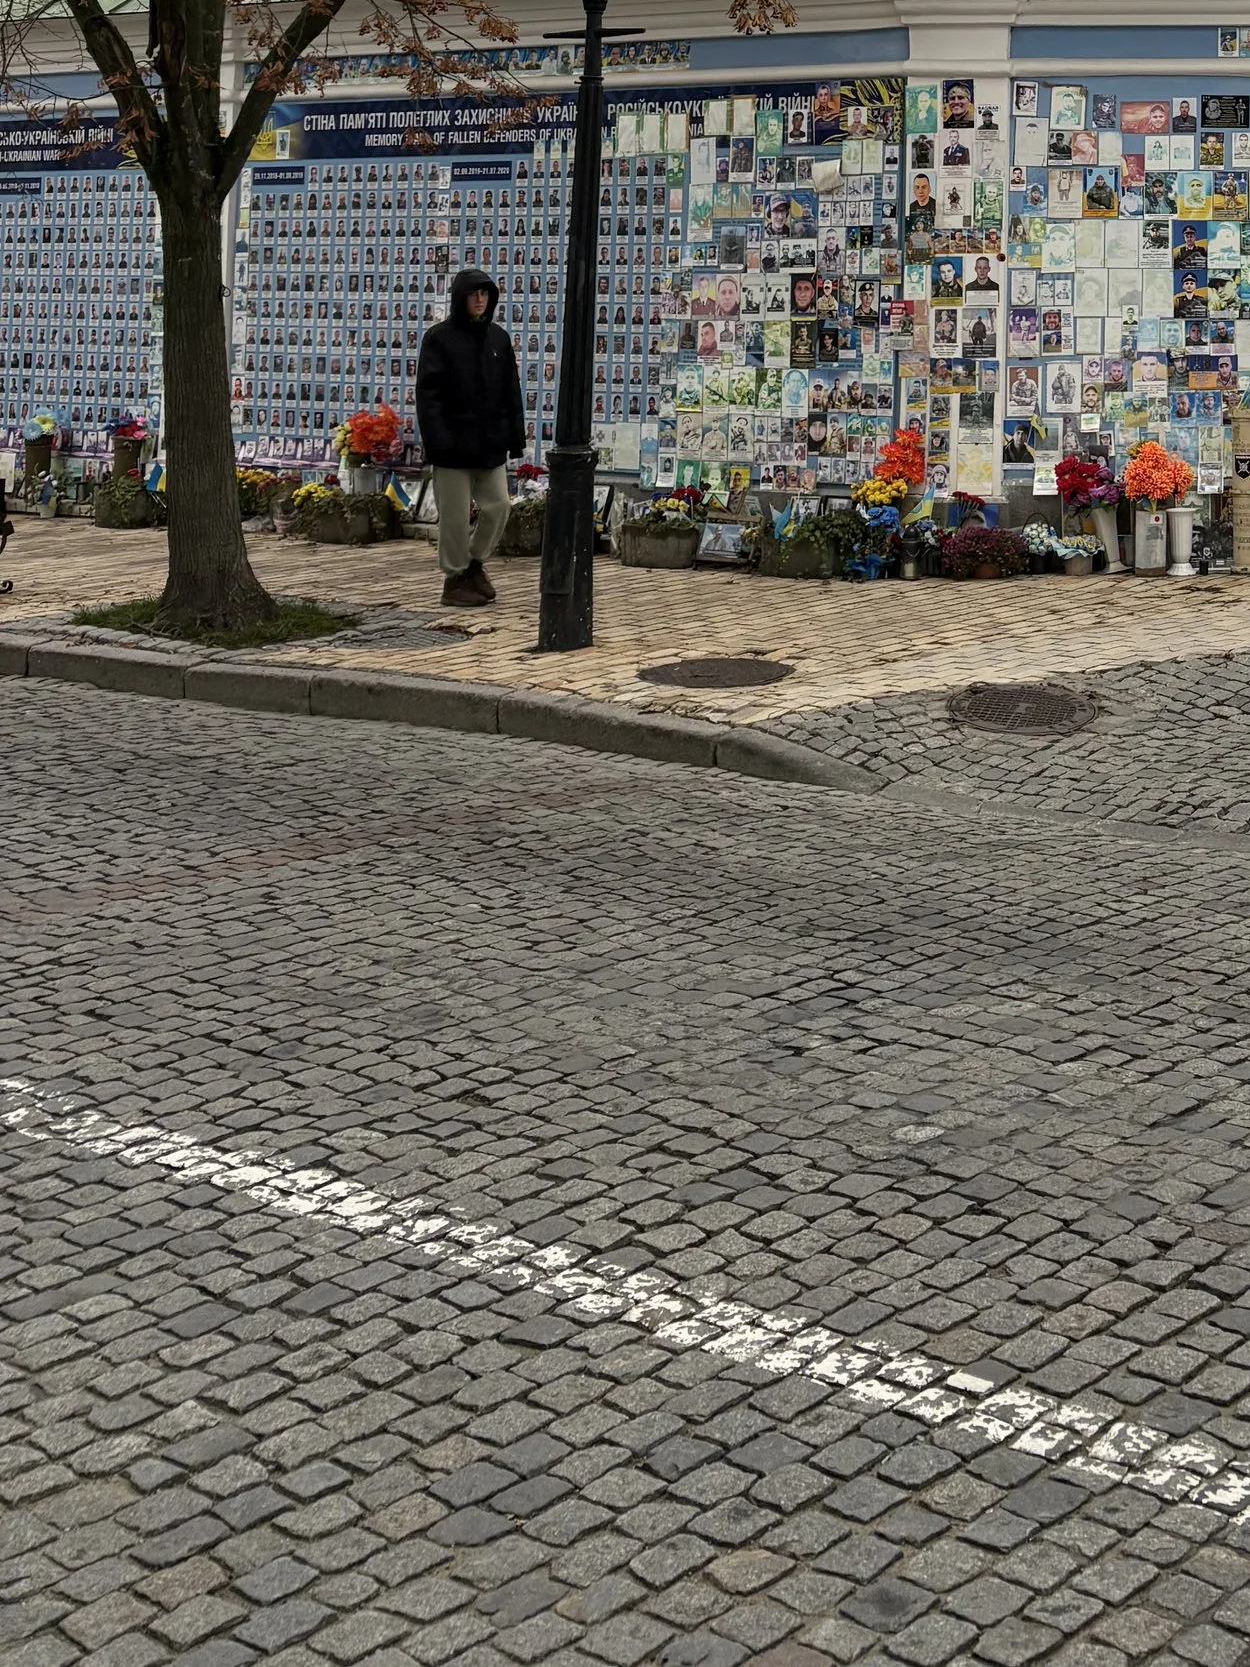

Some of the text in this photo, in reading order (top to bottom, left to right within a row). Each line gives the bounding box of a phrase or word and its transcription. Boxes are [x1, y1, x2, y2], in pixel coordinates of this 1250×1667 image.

[303, 114, 336, 131] СТІНА
[339, 112, 387, 130] ПАМ'ЯТІ
[389, 110, 451, 128] ПОЛЕГЛИХ
[454, 106, 531, 125] ЗАХИСНИВ
[364, 133, 403, 147] MEMORY
[434, 131, 445, 144] OF
[448, 130, 480, 144] FALLEN
[540, 128, 551, 141] OF
